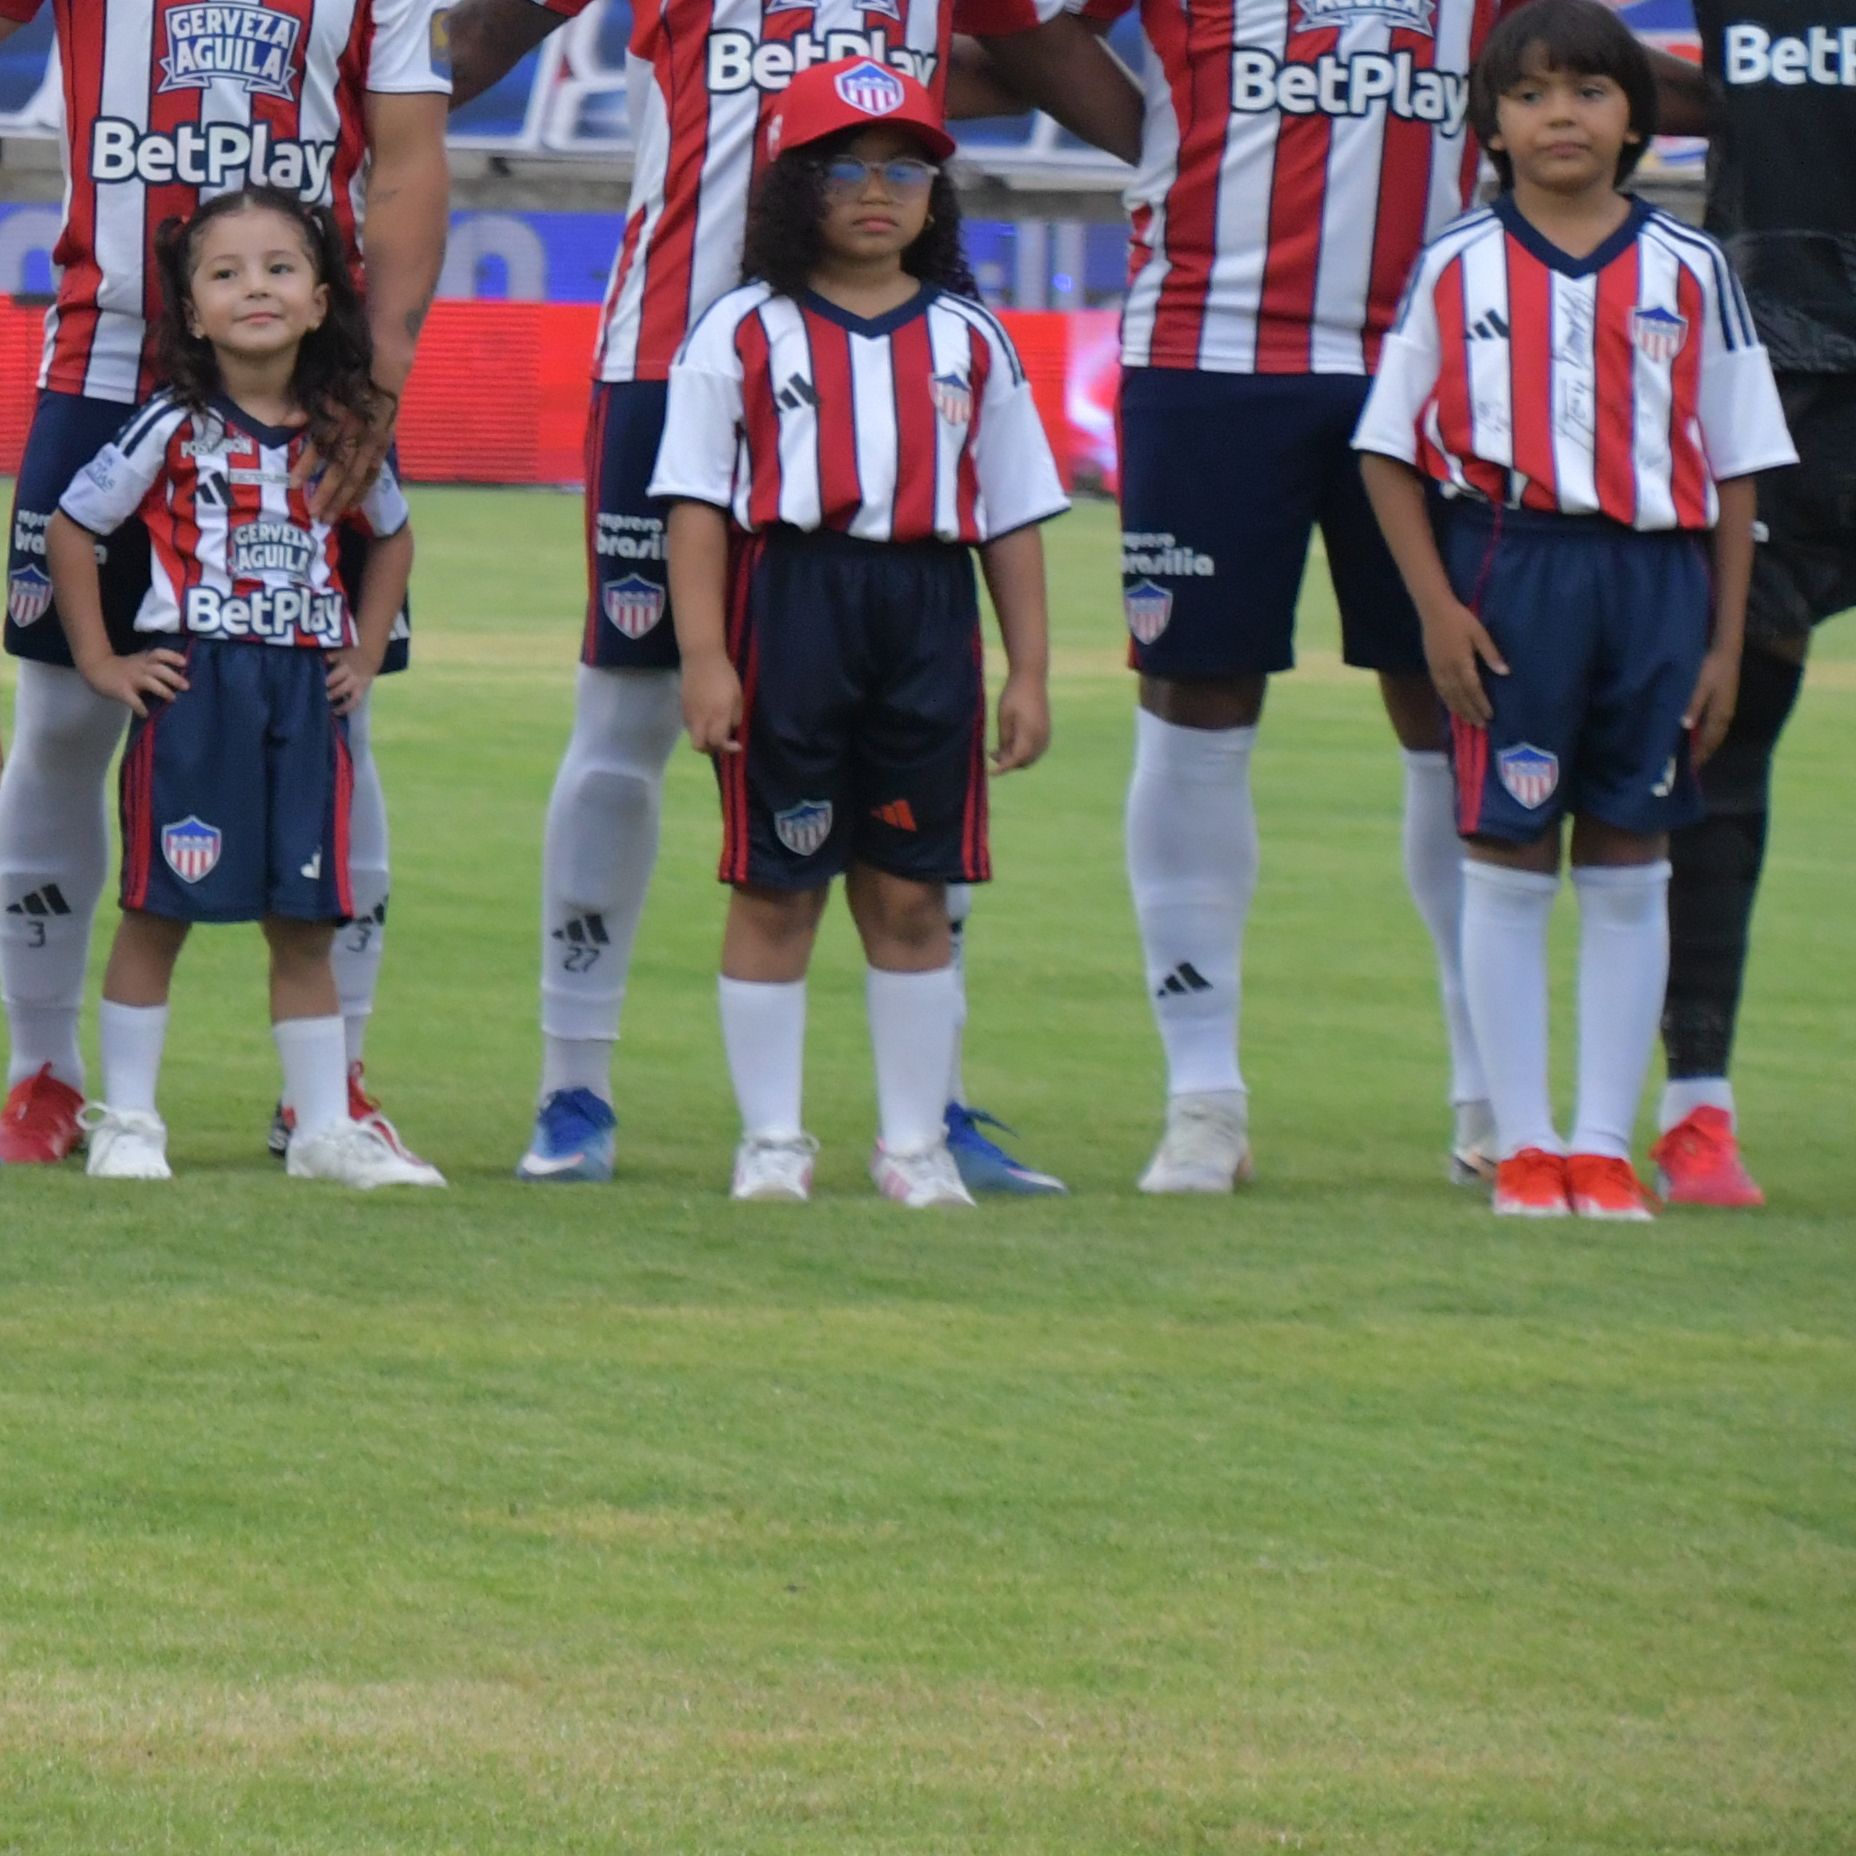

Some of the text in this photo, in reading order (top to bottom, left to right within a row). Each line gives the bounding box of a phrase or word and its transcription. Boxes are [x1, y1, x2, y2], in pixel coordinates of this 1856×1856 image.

[173, 42, 285, 84] AGUILA
[1231, 49, 1468, 137] BetPlay
[92, 117, 336, 202] BetPlay
[237, 544, 313, 574] AGUILA
[188, 586, 343, 640] BetPlay
